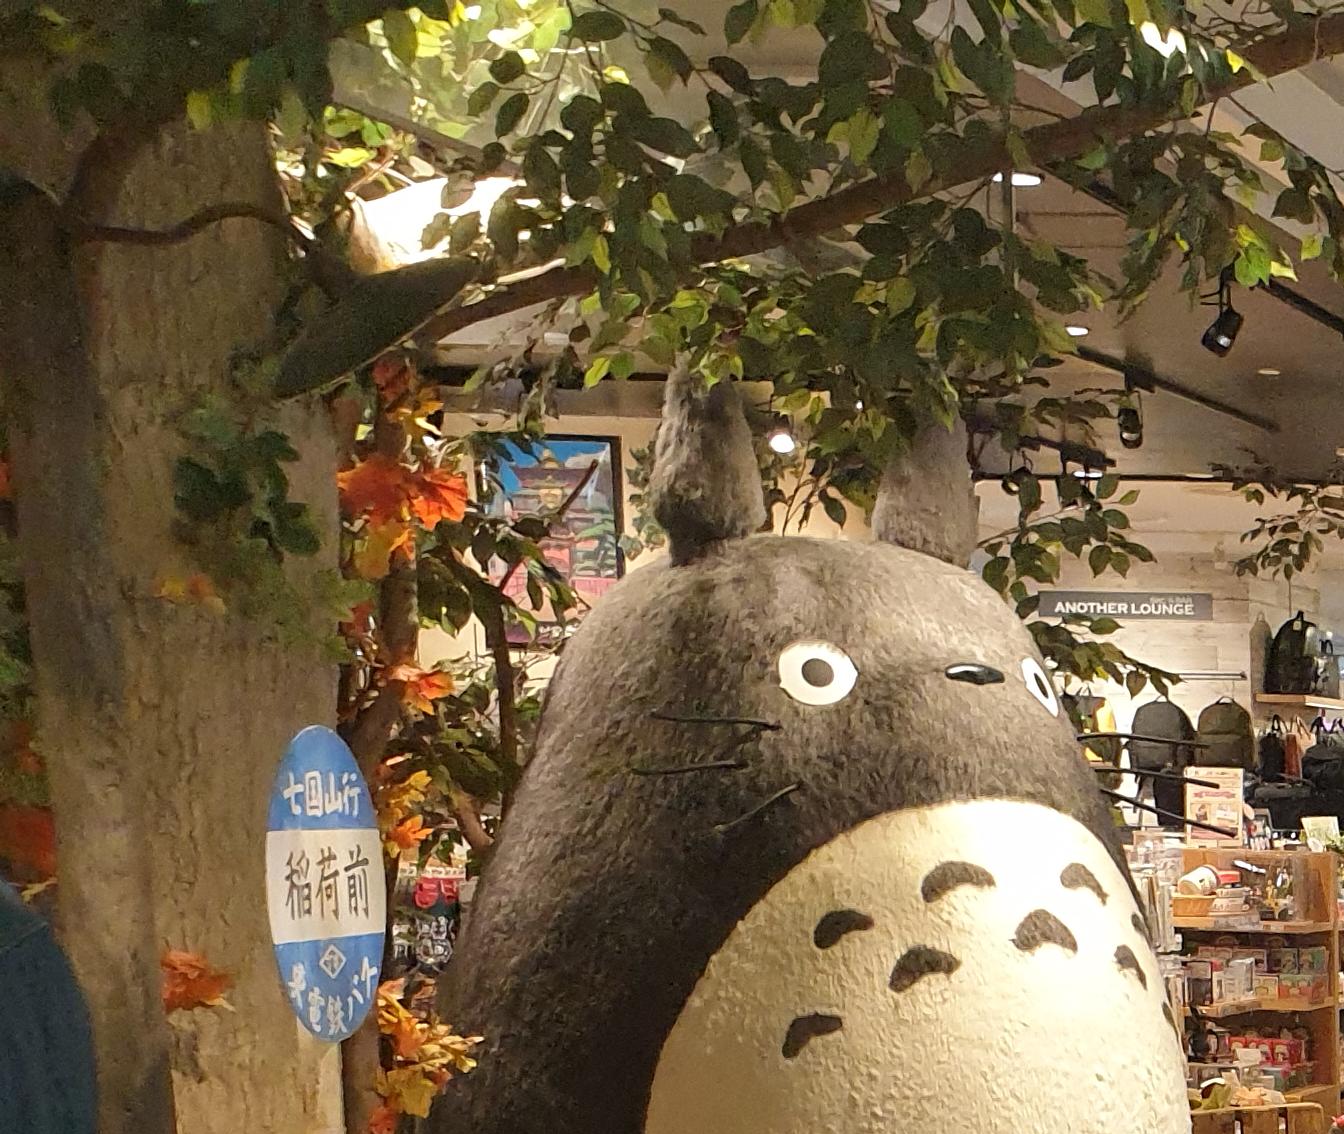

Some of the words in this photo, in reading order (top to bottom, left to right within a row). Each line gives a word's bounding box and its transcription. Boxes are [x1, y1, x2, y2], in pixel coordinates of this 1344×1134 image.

[1055, 602, 1128, 613] ANOTHER
[1131, 603, 1194, 615] LOUNGE
[285, 845, 369, 920] 稲荷前
